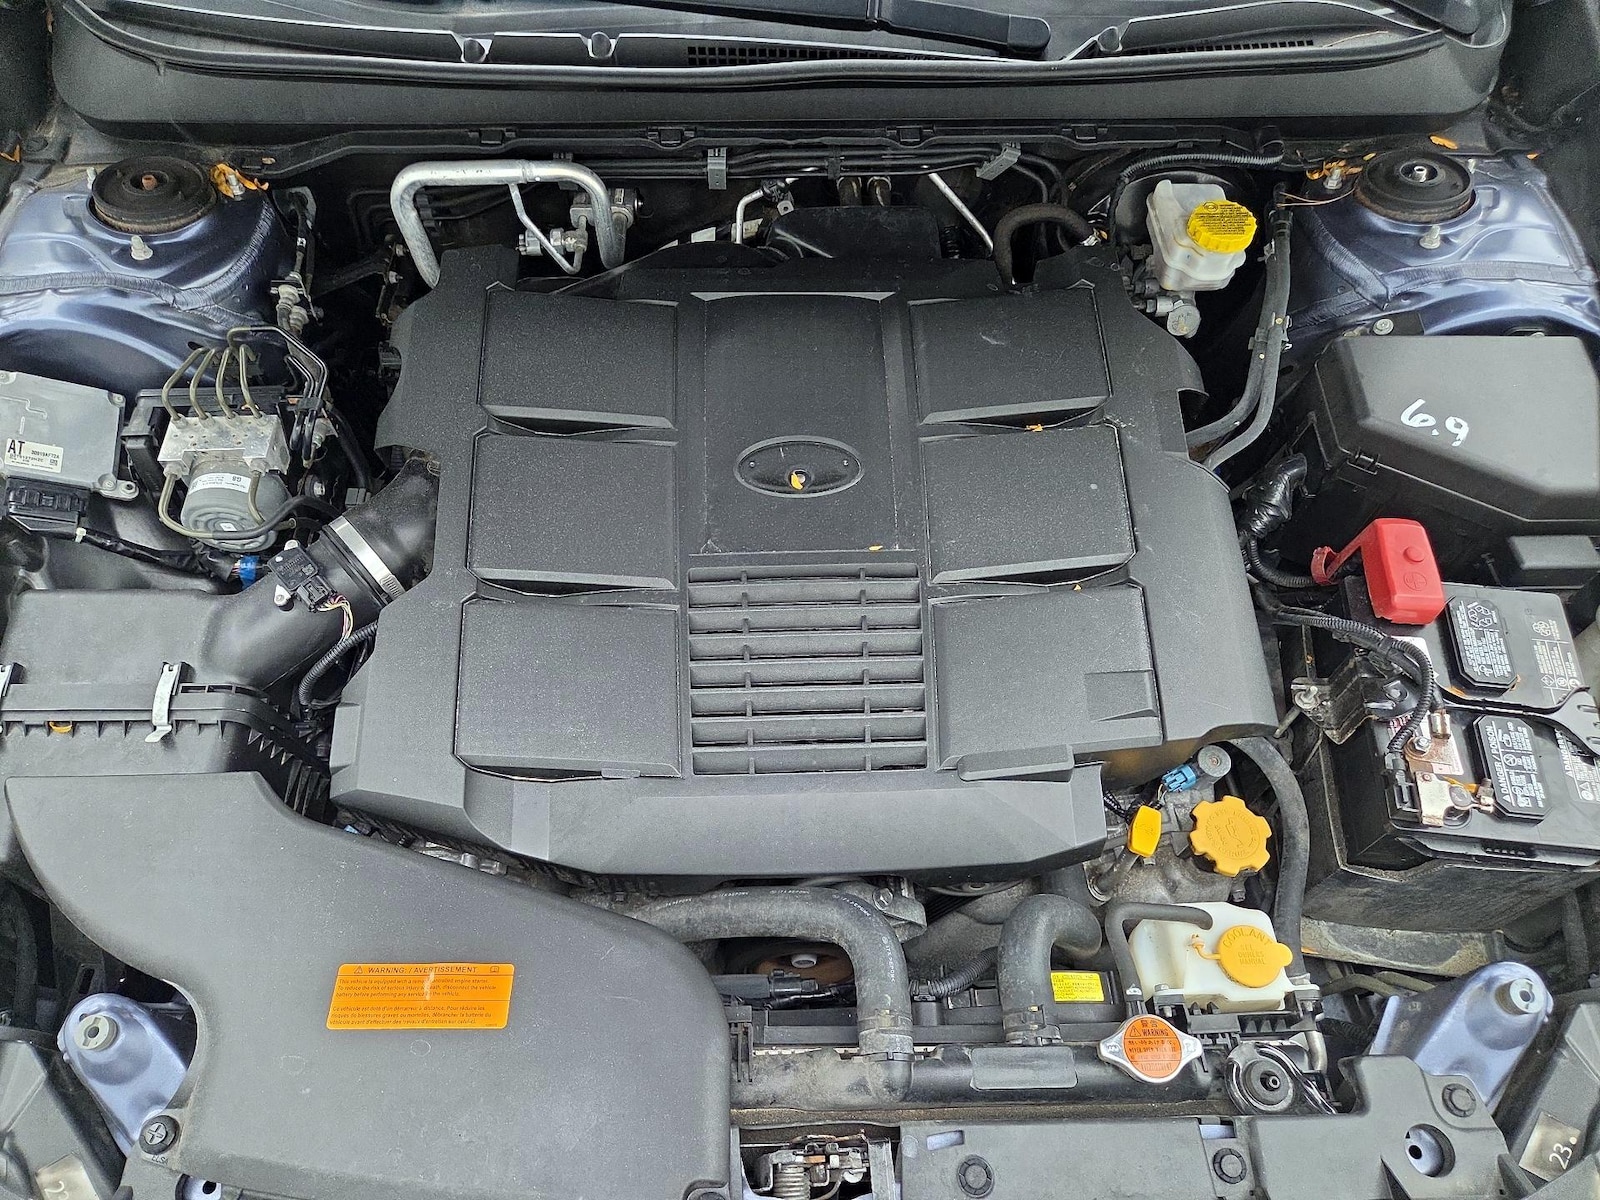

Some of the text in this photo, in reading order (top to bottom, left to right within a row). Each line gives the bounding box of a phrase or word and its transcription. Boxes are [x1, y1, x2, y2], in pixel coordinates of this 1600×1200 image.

[1400, 398, 1469, 446] 6.9
[8, 439, 25, 455] AT
[1484, 725, 1498, 753] POISON
[1556, 732, 1570, 772] DANGER
[1493, 761, 1508, 793] DANGER
[1222, 927, 1273, 949] COOLANT
[1240, 958, 1266, 966] MANUAL
[1142, 1028, 1168, 1036] WARNING
